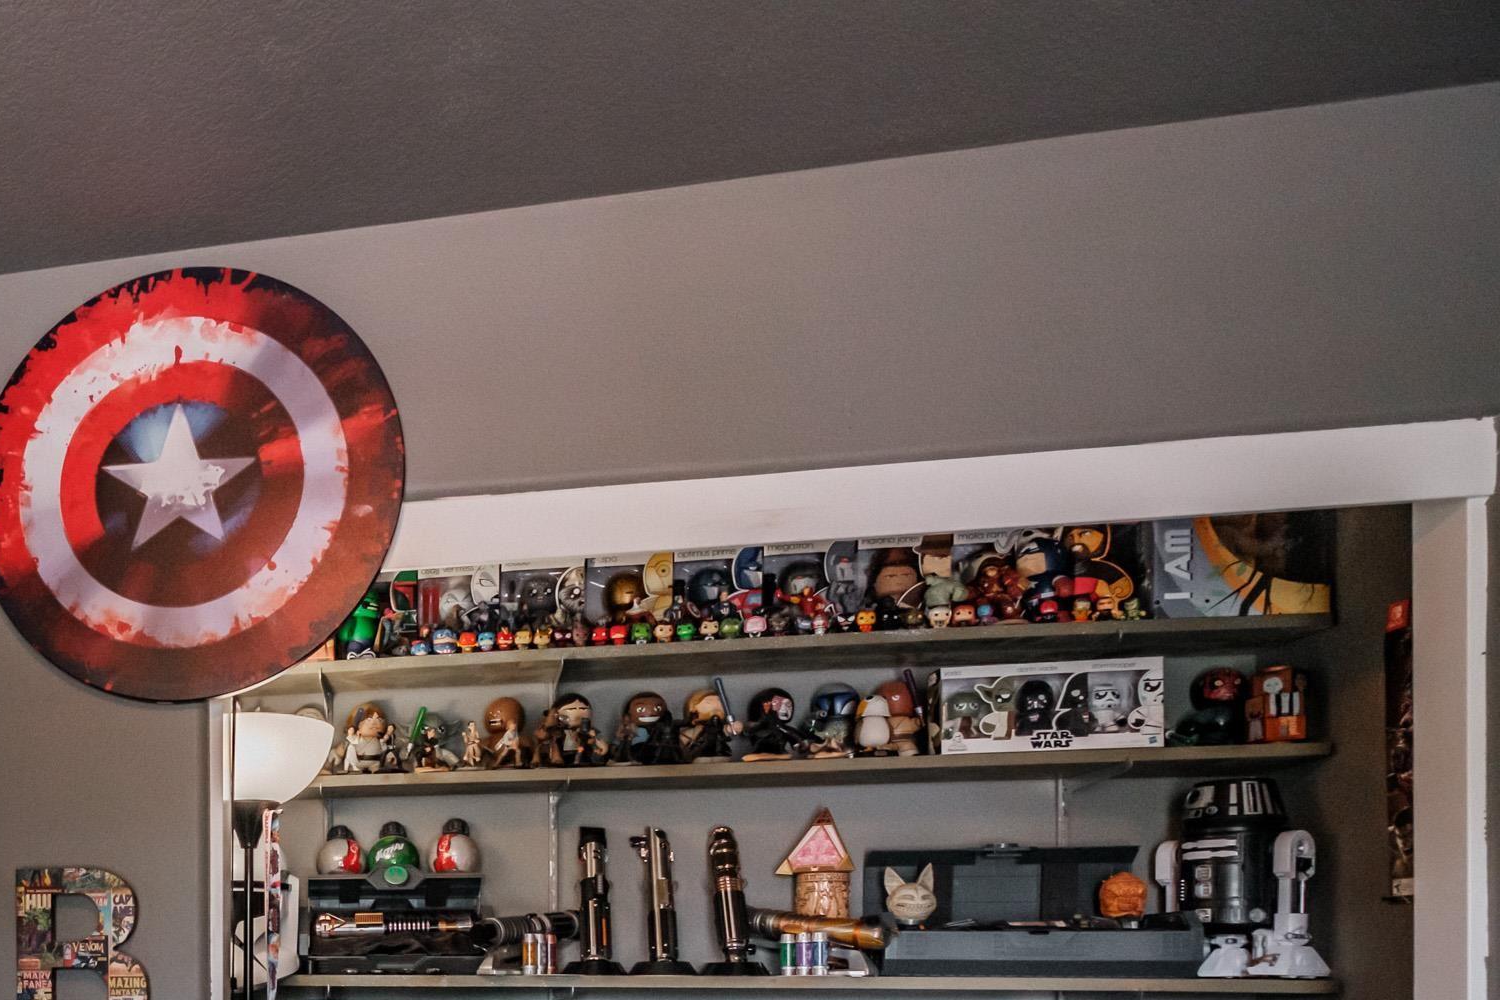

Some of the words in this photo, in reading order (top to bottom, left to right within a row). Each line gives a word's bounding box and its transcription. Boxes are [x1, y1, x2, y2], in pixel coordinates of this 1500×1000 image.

[1164, 528, 1193, 580] AM
[1030, 731, 1074, 741] STAR
[1031, 739, 1074, 749] WARS
[73, 941, 105, 953] VENOM
